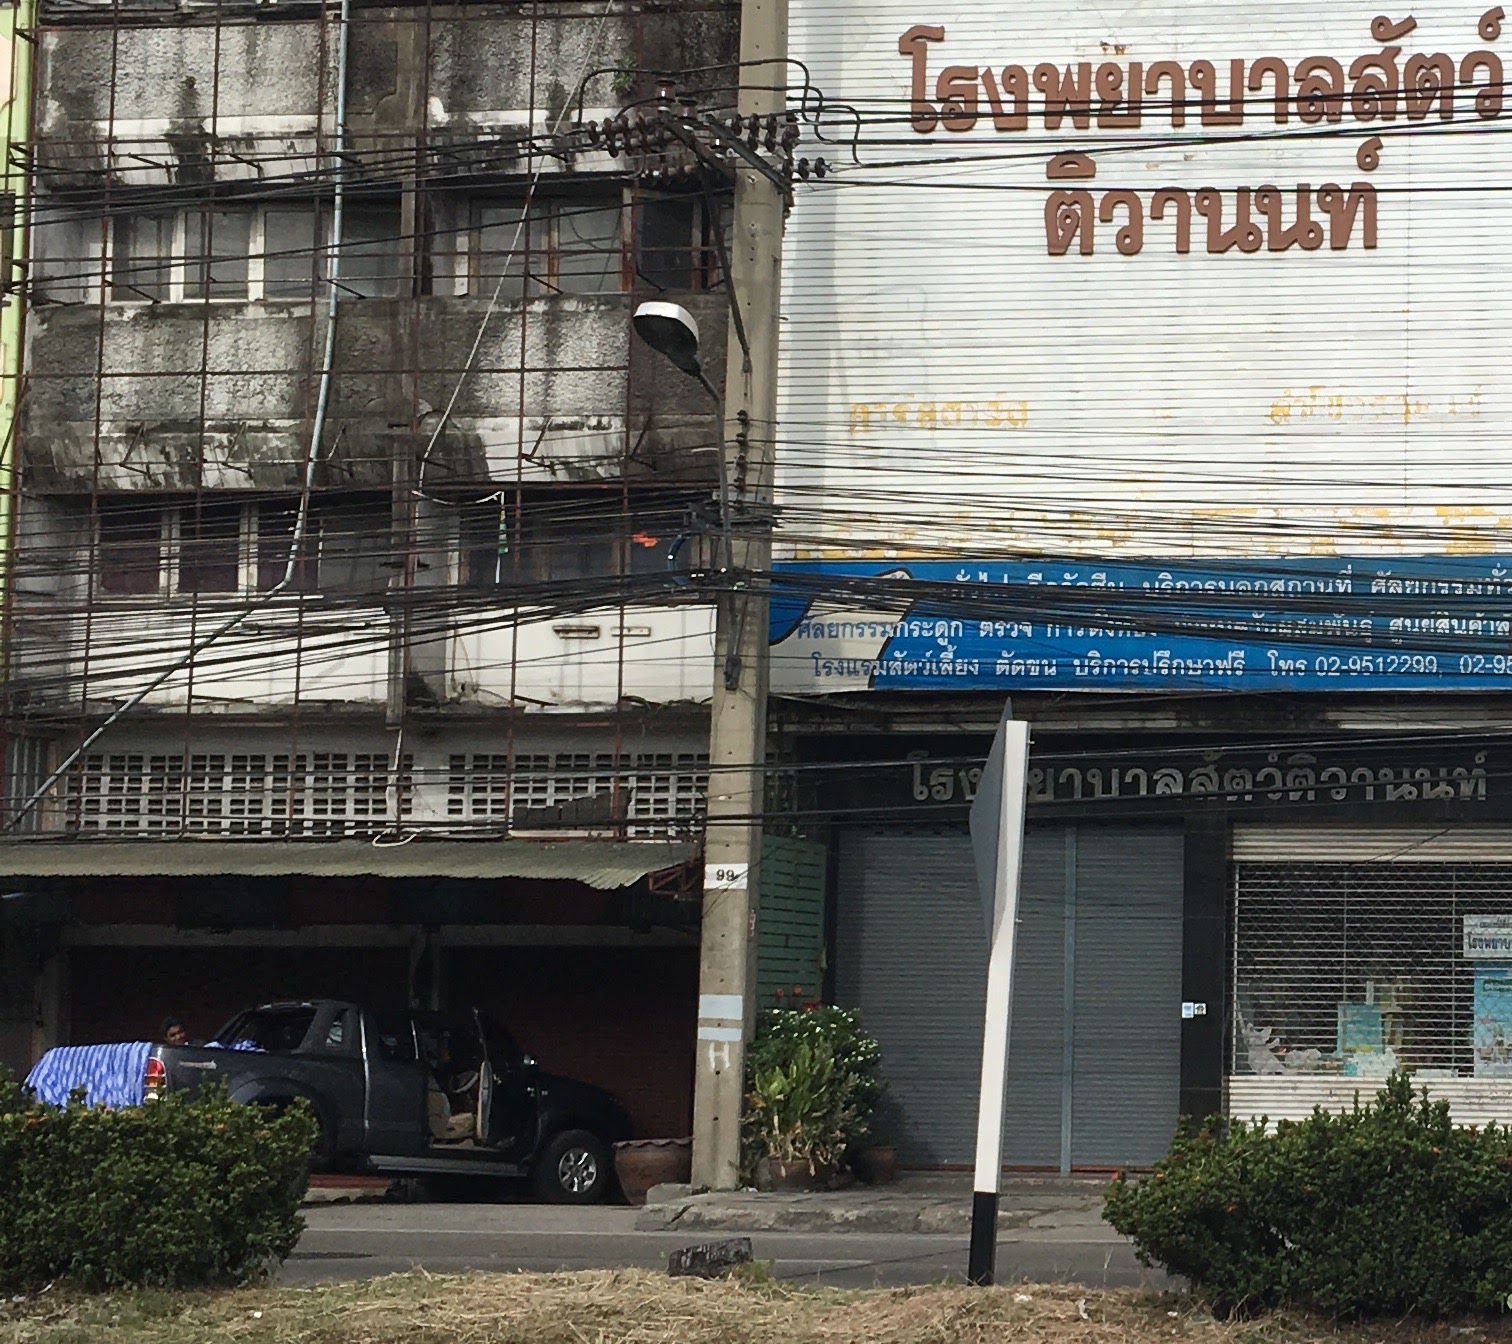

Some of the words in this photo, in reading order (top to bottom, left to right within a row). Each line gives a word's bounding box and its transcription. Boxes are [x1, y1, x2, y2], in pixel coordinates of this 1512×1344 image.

[899, 6, 1505, 132] โรงพยาบาลสัตว์
[1044, 136, 1386, 256] ติวานนท์
[811, 645, 980, 676] โรงแรมสัตว์เลี้ยง
[1266, 649, 1308, 676] โทร
[908, 749, 1488, 802] โรงยาบาลสัตว์ติวานนท์
